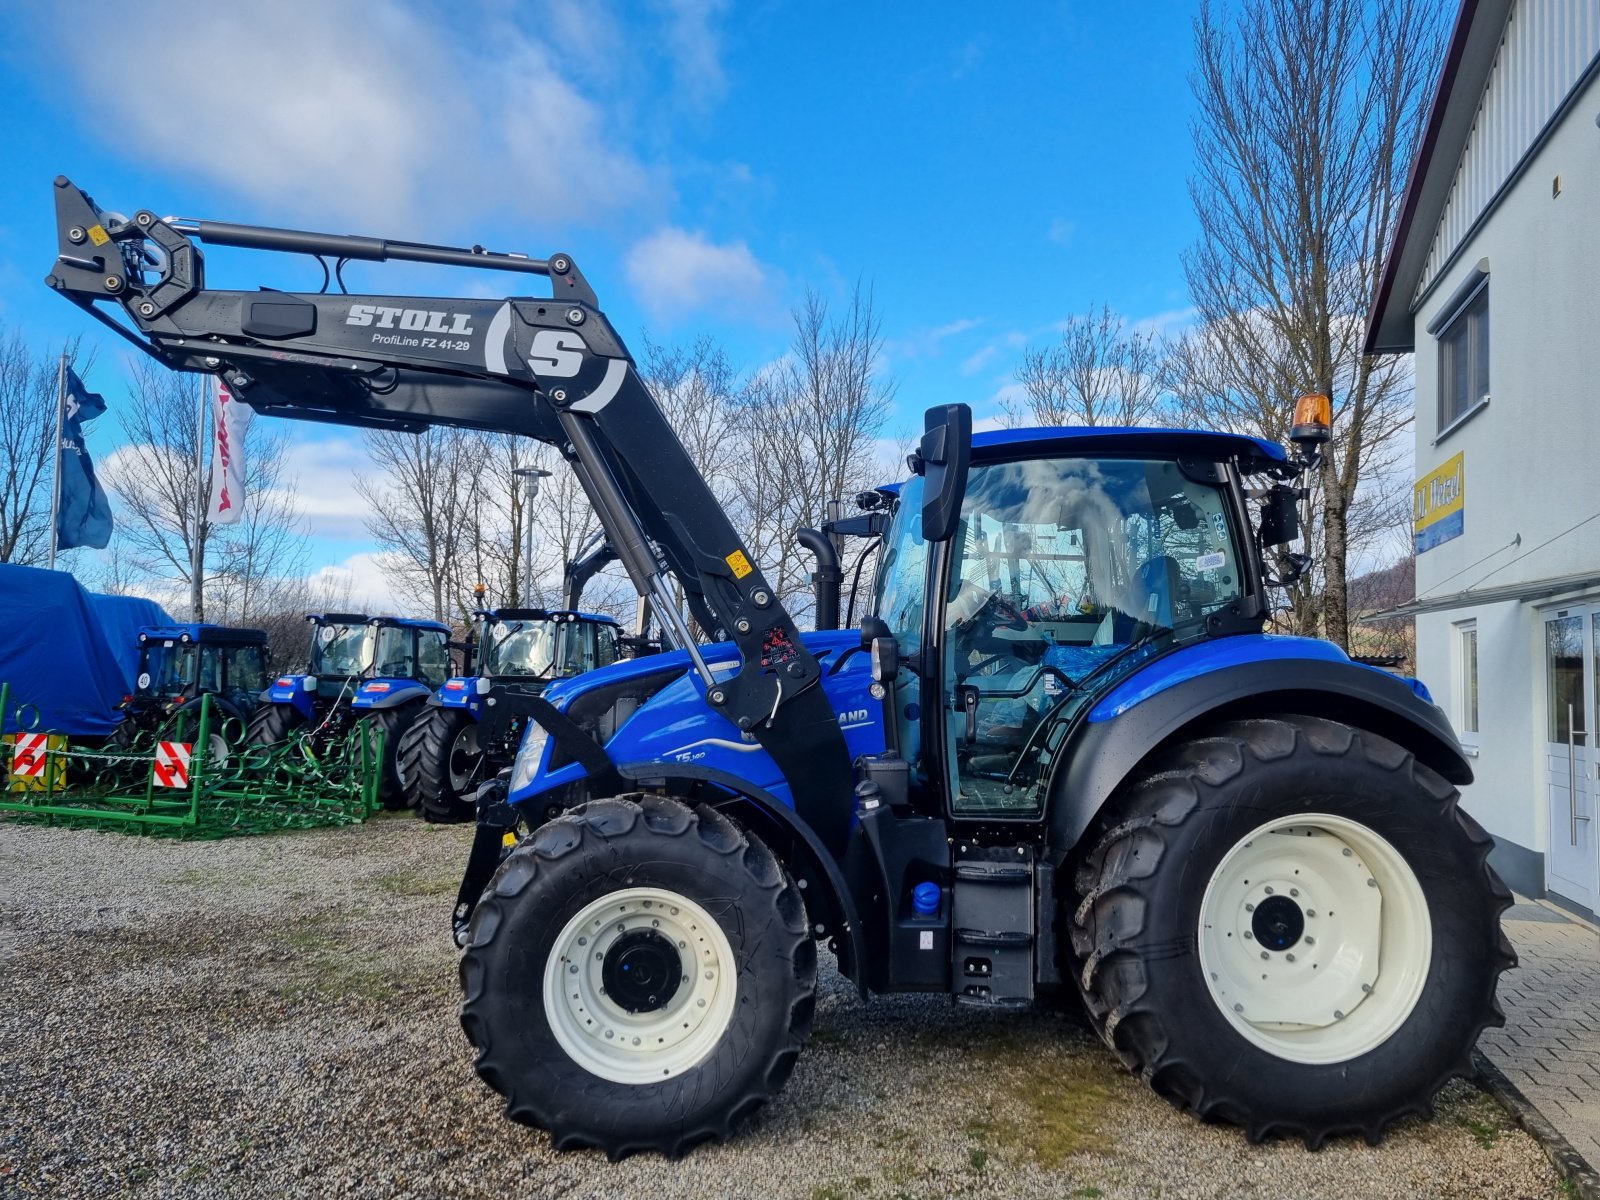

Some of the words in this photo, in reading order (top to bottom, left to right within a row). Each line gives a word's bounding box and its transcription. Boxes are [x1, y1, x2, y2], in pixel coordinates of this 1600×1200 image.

[345, 304, 474, 336] STOLL
[371, 333, 419, 347] ProfiLine
[421, 338, 437, 348] FZ
[438, 340, 470, 351] 41-29
[494, 626, 505, 637] 40
[140, 675, 148, 686] 40
